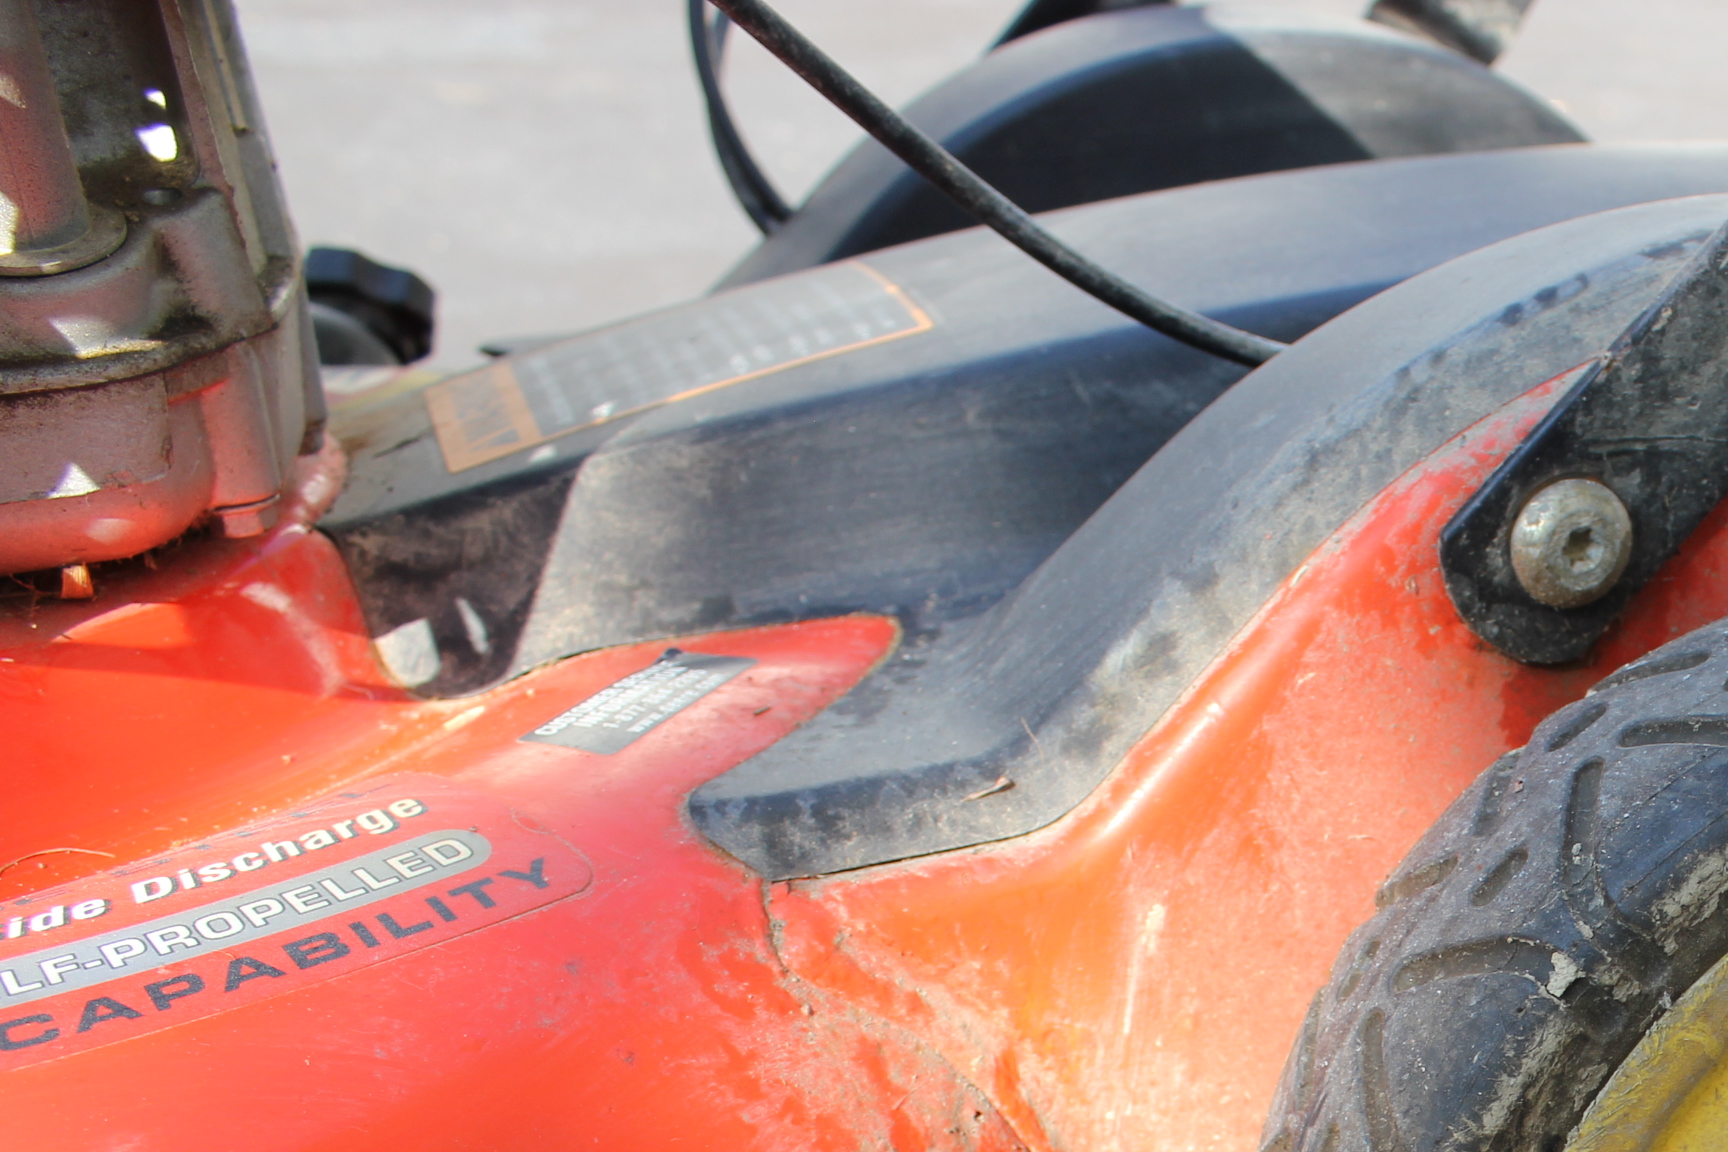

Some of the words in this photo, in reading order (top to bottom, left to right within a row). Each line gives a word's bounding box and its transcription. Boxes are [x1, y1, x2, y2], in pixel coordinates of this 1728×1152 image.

[0, 898, 110, 940] ide
[131, 797, 428, 905] Discharge
[0, 836, 474, 997] LF-PROPELLED
[0, 858, 551, 1051] CAPABILITY
